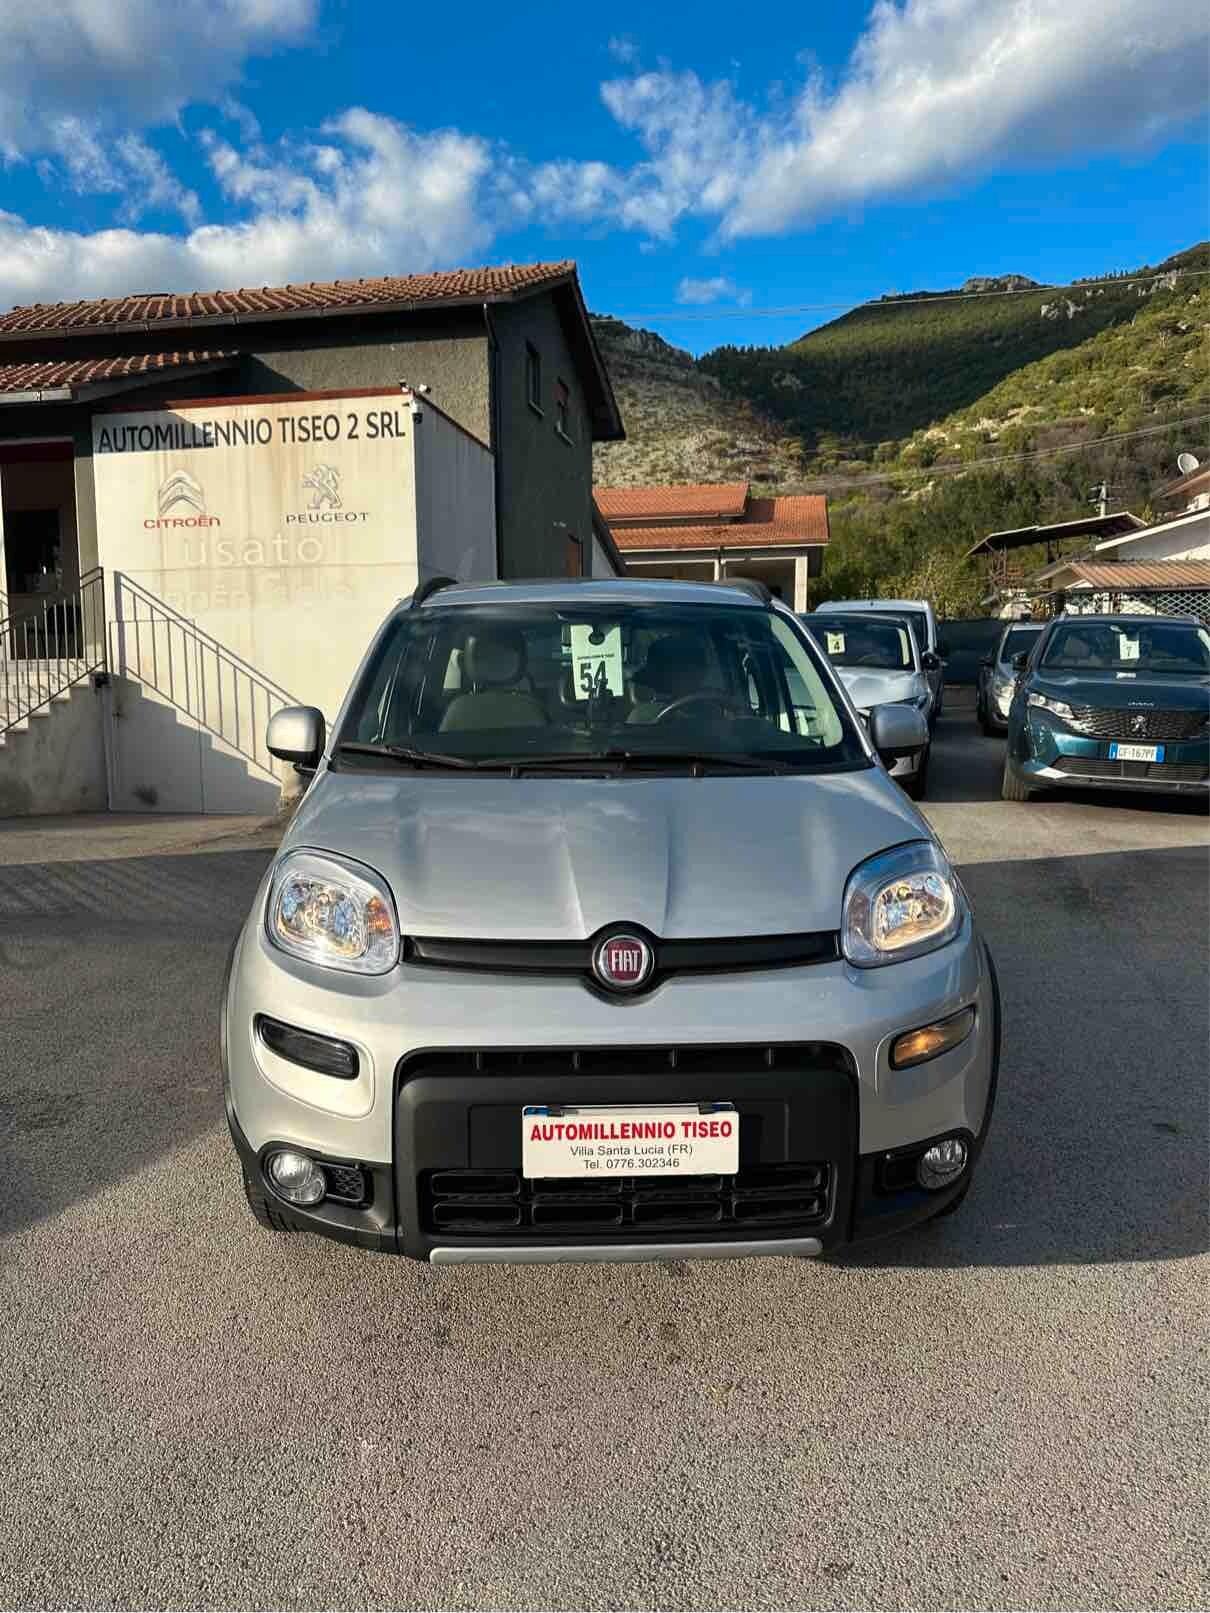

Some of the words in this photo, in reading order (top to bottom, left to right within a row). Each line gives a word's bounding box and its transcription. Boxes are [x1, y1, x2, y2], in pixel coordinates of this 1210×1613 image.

[99, 417, 273, 452] AUTOMILLENNIO
[277, 414, 340, 444] TISEO
[347, 413, 359, 439] 2
[366, 411, 406, 437] SRL
[286, 511, 369, 525] PEUGEOT
[183, 532, 323, 567] usato
[580, 660, 609, 693] 54
[611, 949, 640, 972] FIAT
[530, 1122, 676, 1141] AUTOMILLENNIO
[681, 1121, 732, 1138] TISEO
[570, 1145, 594, 1157] Villa
[597, 1144, 631, 1156] Santa
[634, 1143, 664, 1156] Lucia
[667, 1143, 693, 1156] (FR)
[584, 1158, 602, 1170] Tel.
[606, 1157, 680, 1169] 0776.302346
